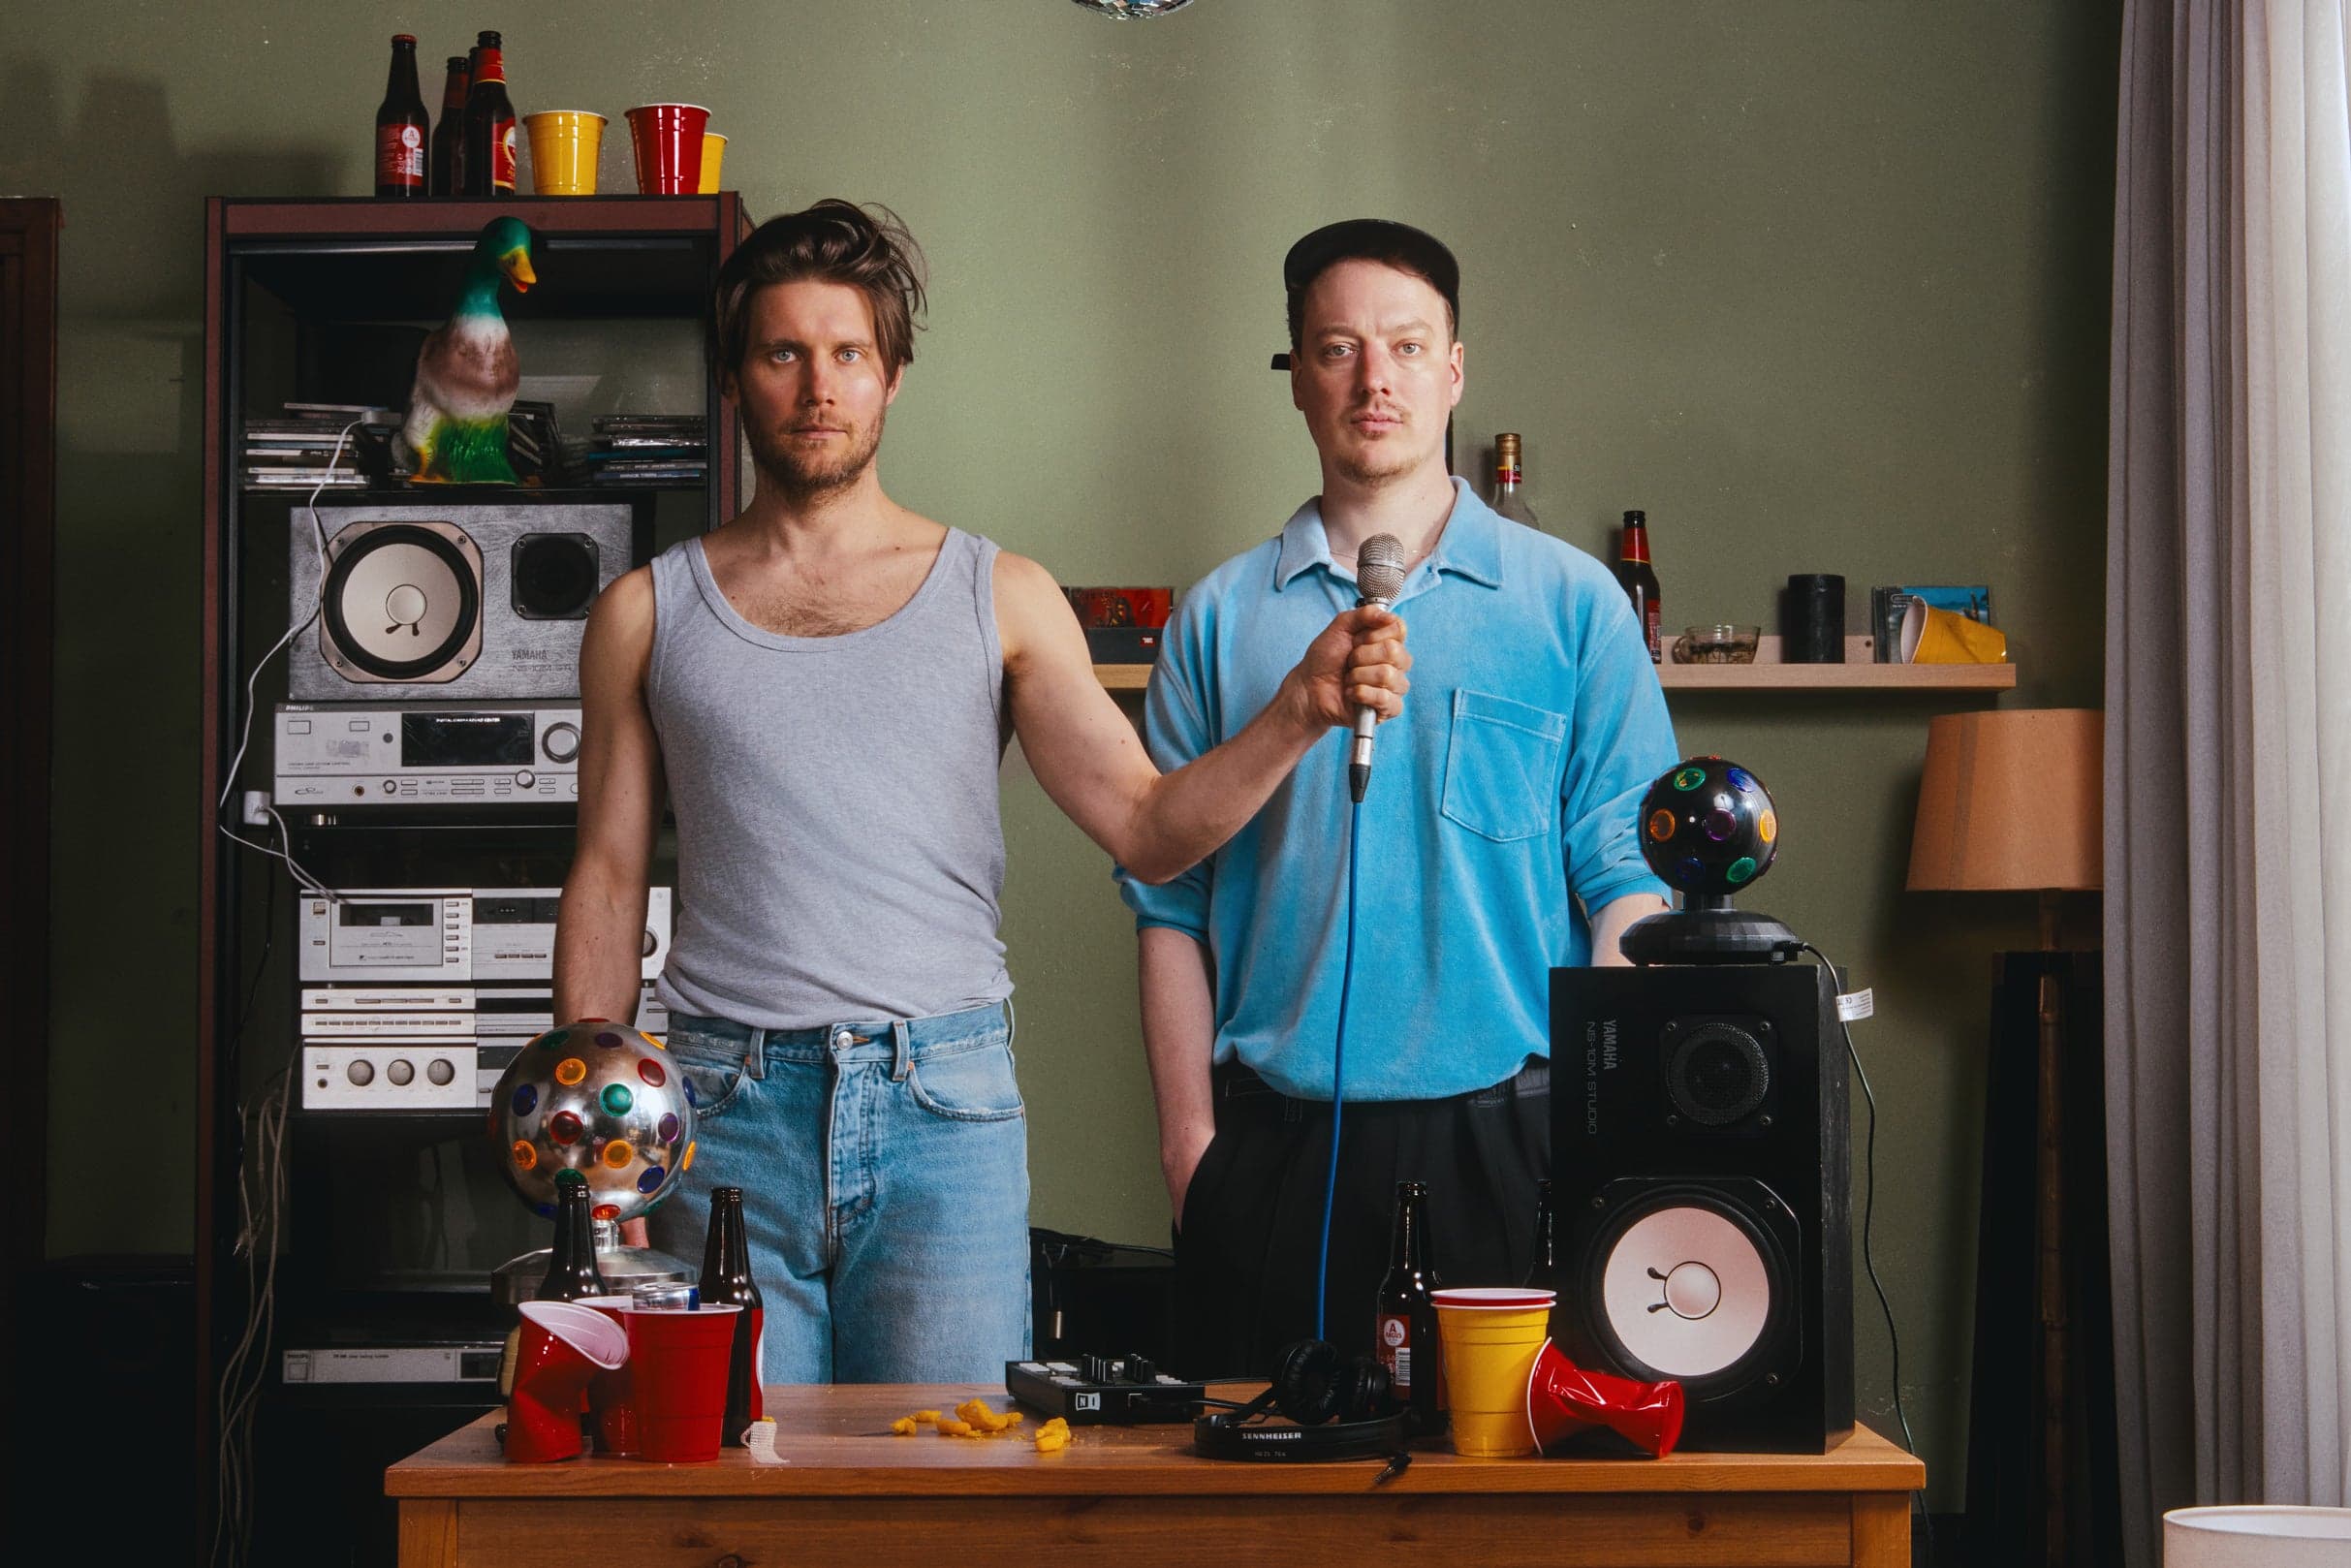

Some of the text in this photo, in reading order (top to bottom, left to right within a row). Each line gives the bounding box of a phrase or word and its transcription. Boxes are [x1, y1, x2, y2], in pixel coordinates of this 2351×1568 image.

[512, 648, 549, 660] YAMAHA
[1603, 1019, 1617, 1070] YAMAHA
[1587, 1020, 1597, 1134] NS-10M STUDIO
